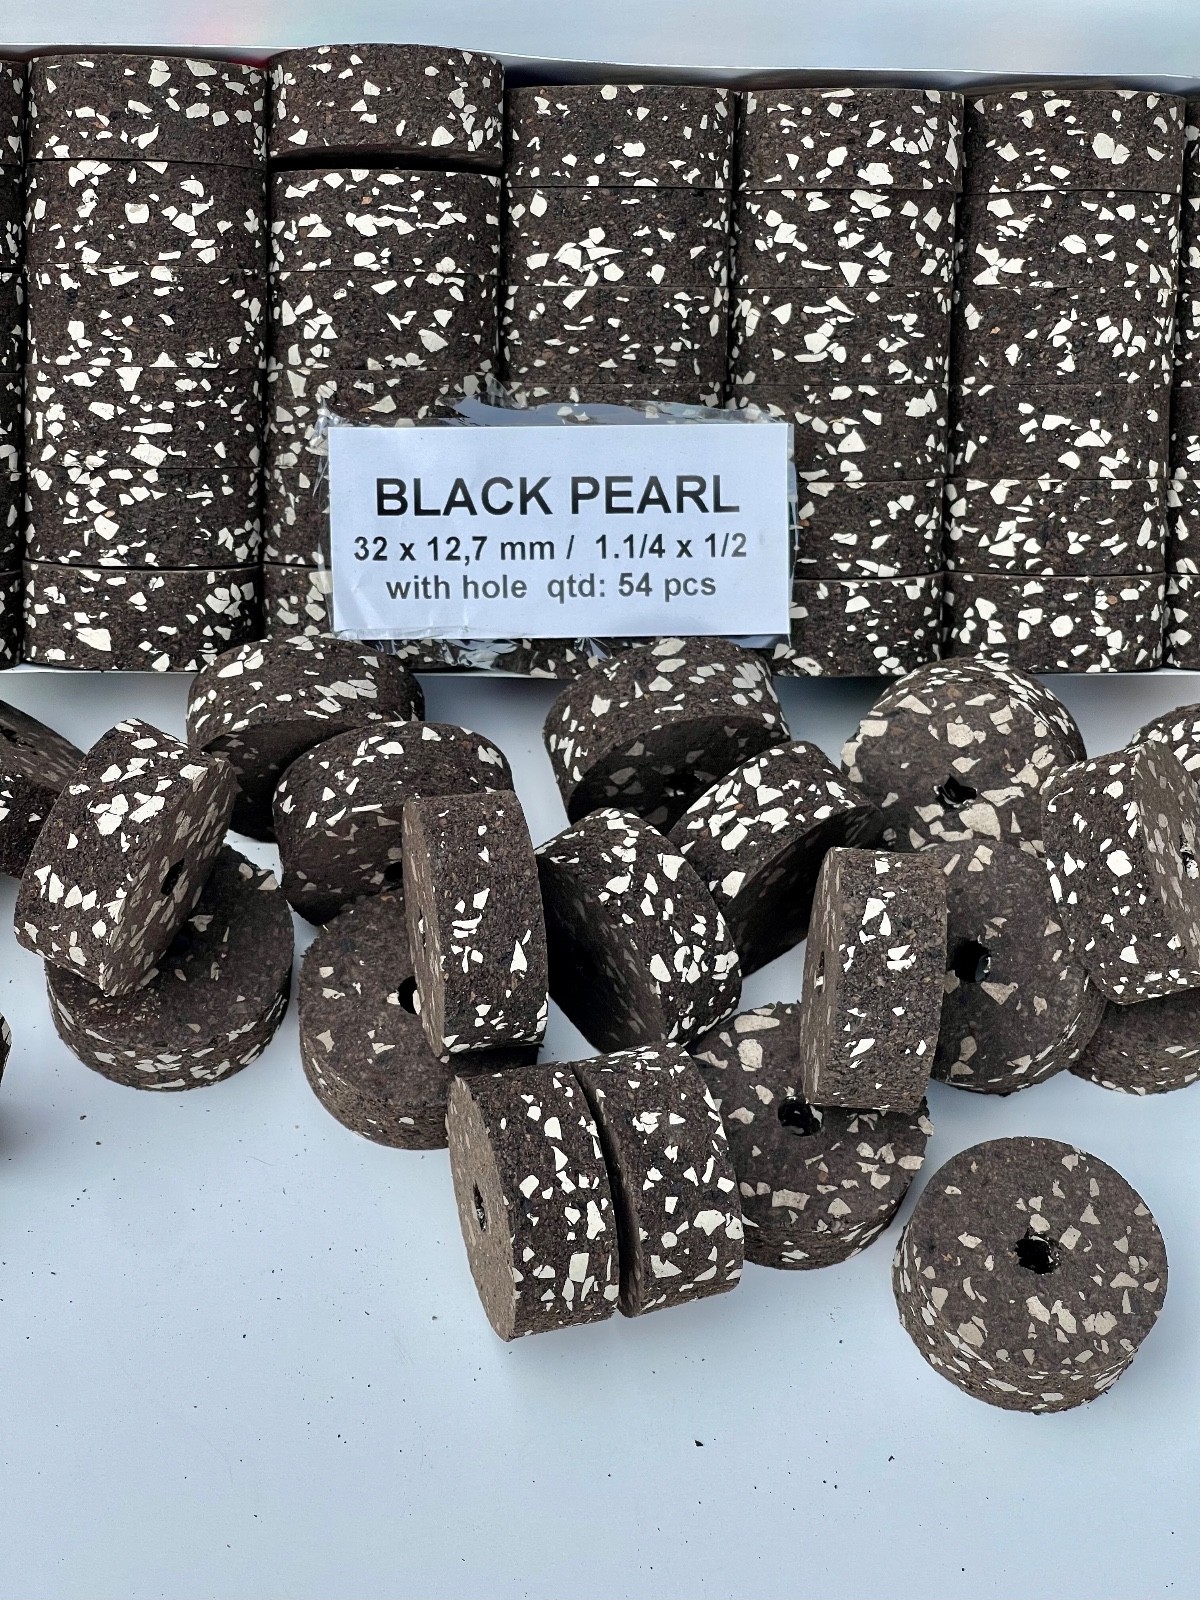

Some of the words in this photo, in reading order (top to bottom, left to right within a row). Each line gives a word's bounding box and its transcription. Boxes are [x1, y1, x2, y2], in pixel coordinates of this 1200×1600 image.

[377, 476, 553, 517] BLACK
[571, 475, 739, 515] PEARL
[354, 536, 387, 562] 32
[399, 542, 416, 562] x
[428, 535, 487, 566] 12,7
[500, 541, 555, 560] mm
[567, 534, 574, 560] /
[596, 533, 665, 560] 1.1/4
[676, 540, 692, 558] x
[705, 532, 746, 558] 1/2
[386, 574, 450, 600] with
[463, 574, 527, 600] hole
[548, 573, 605, 604] qtd:
[618, 572, 653, 597] 54
[664, 577, 716, 603] pcs
